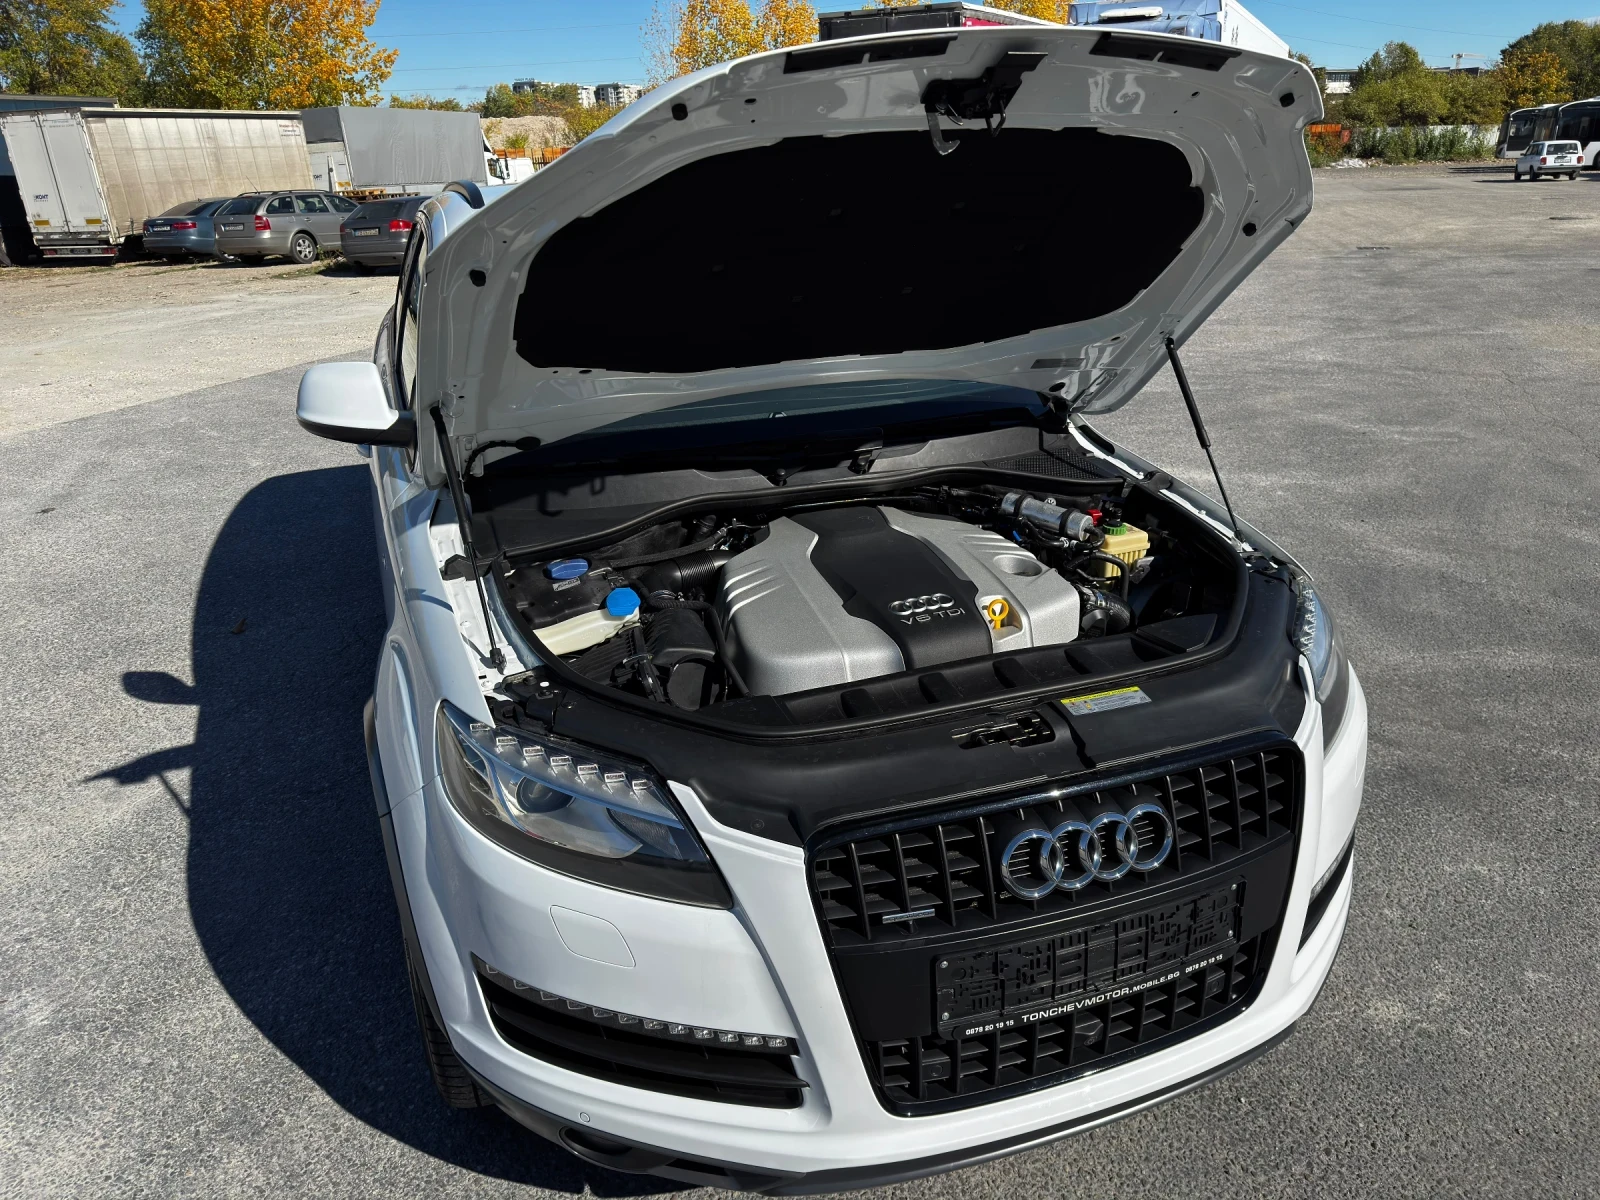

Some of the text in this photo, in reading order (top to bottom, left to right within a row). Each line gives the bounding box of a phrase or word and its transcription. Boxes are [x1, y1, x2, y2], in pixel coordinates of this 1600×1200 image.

[900, 608, 965, 624] V6 TDI
[1021, 971, 1181, 1023] TONCHEVMOTOR.MOBILE.BG
[1005, 1019, 1014, 1027] 15
